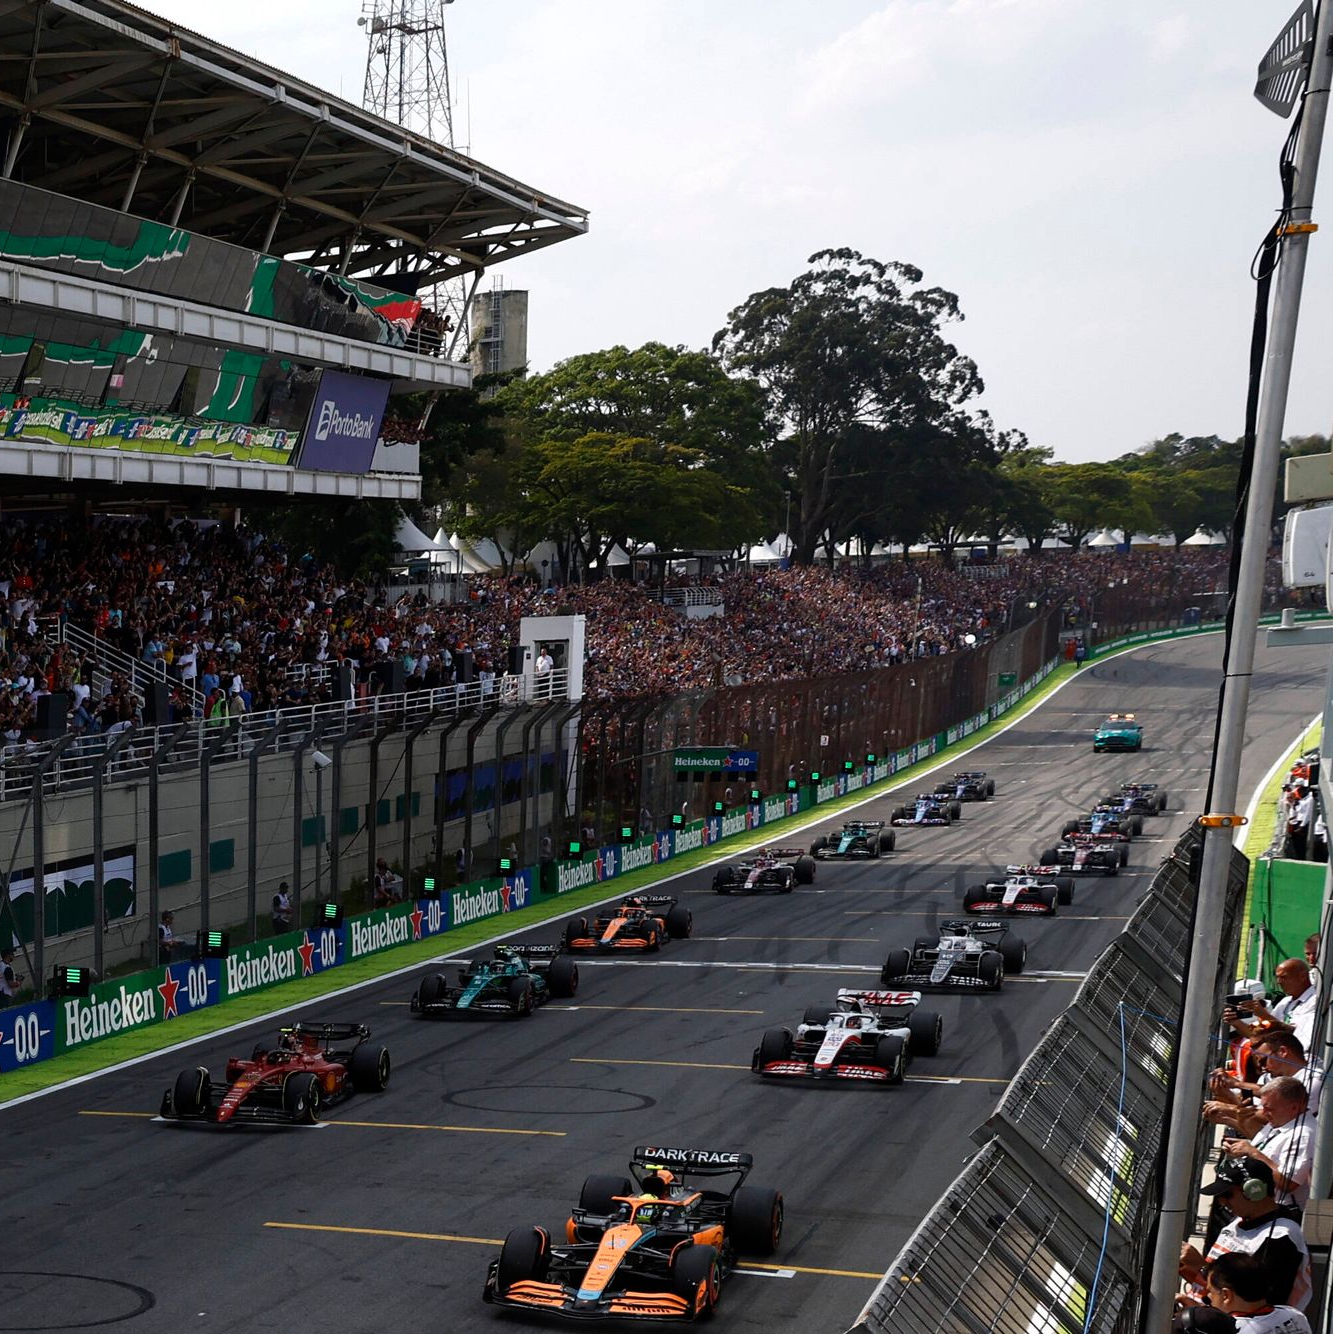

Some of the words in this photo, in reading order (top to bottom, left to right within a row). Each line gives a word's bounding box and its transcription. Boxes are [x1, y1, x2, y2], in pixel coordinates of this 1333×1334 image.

[675, 756, 721, 767] Heineken
[557, 858, 594, 894] Heineken
[620, 841, 653, 873] Heineken
[452, 884, 499, 926] Heineken
[351, 911, 409, 958] Heineken
[226, 943, 296, 996] Heineken
[320, 927, 337, 967] 0.0
[64, 984, 156, 1046] Heineken
[187, 964, 209, 1007] 0.0
[14, 1012, 40, 1062] 0.0
[644, 1147, 741, 1164] DARKTRACE
